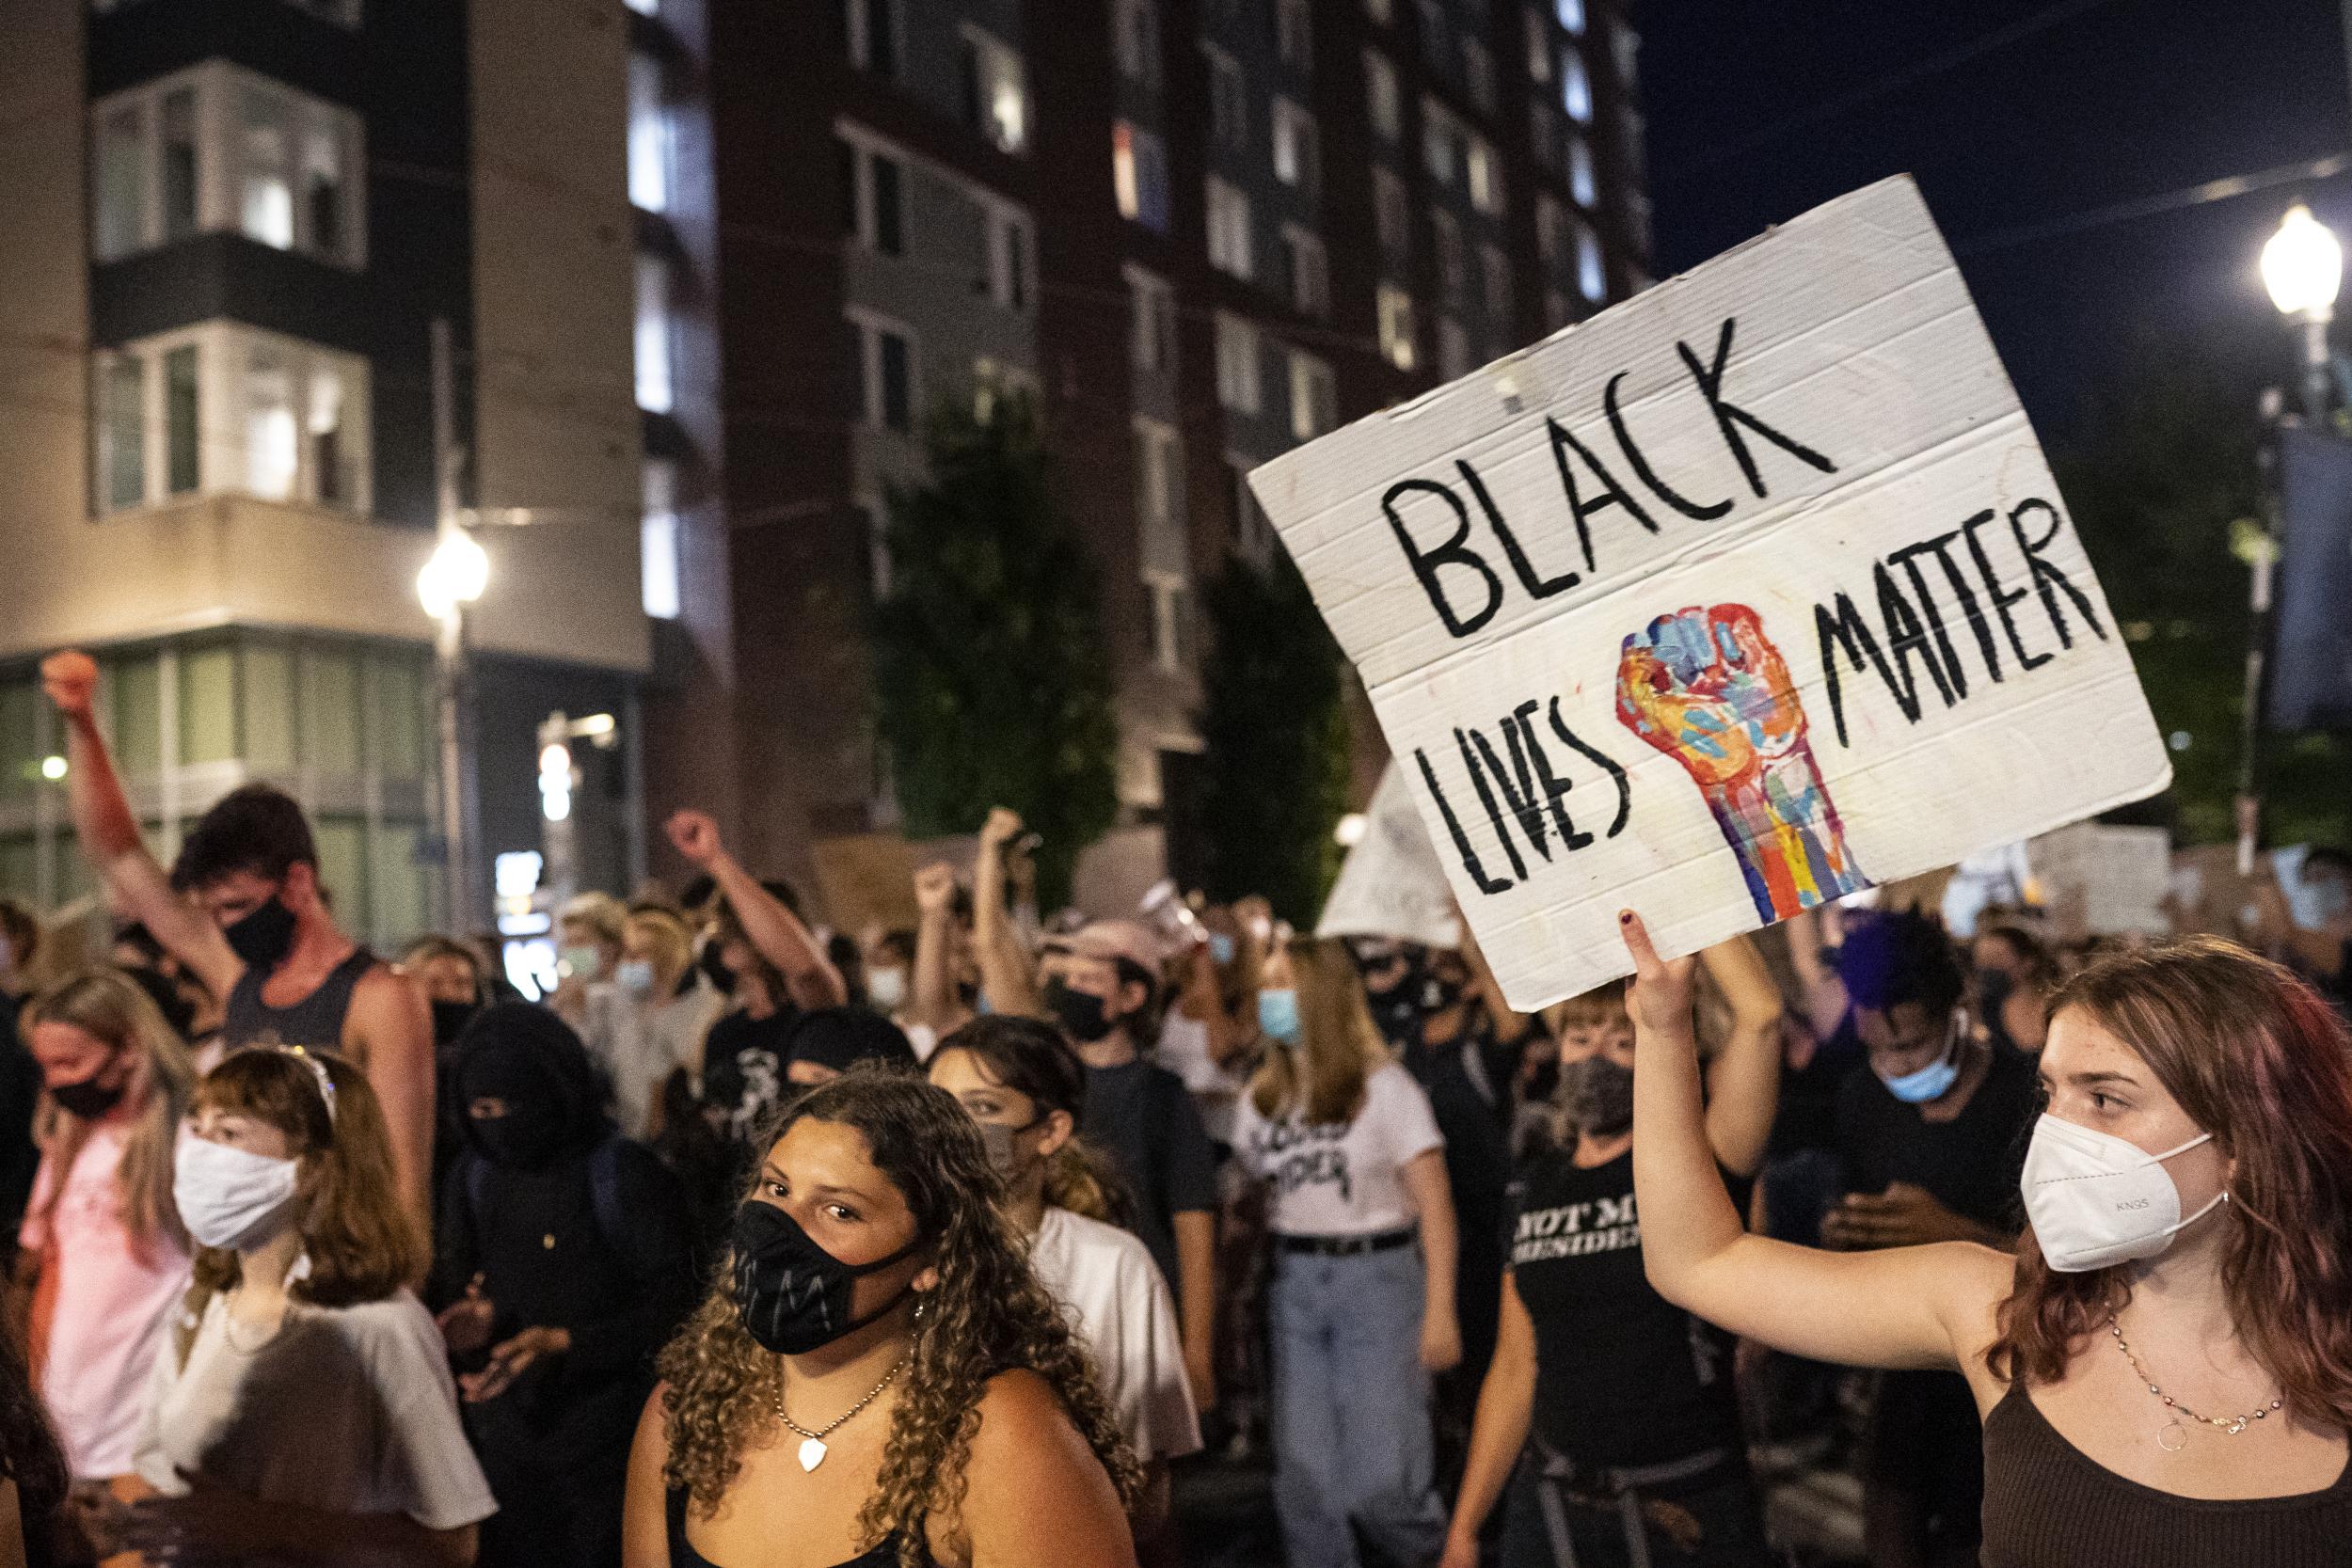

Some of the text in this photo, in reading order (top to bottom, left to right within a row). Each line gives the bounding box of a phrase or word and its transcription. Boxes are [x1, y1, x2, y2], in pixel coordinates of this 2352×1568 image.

[1381, 317, 1837, 639] BLACK
[1414, 498, 2107, 895] LIVES MATTER
[2115, 1197, 2150, 1212] KN95
